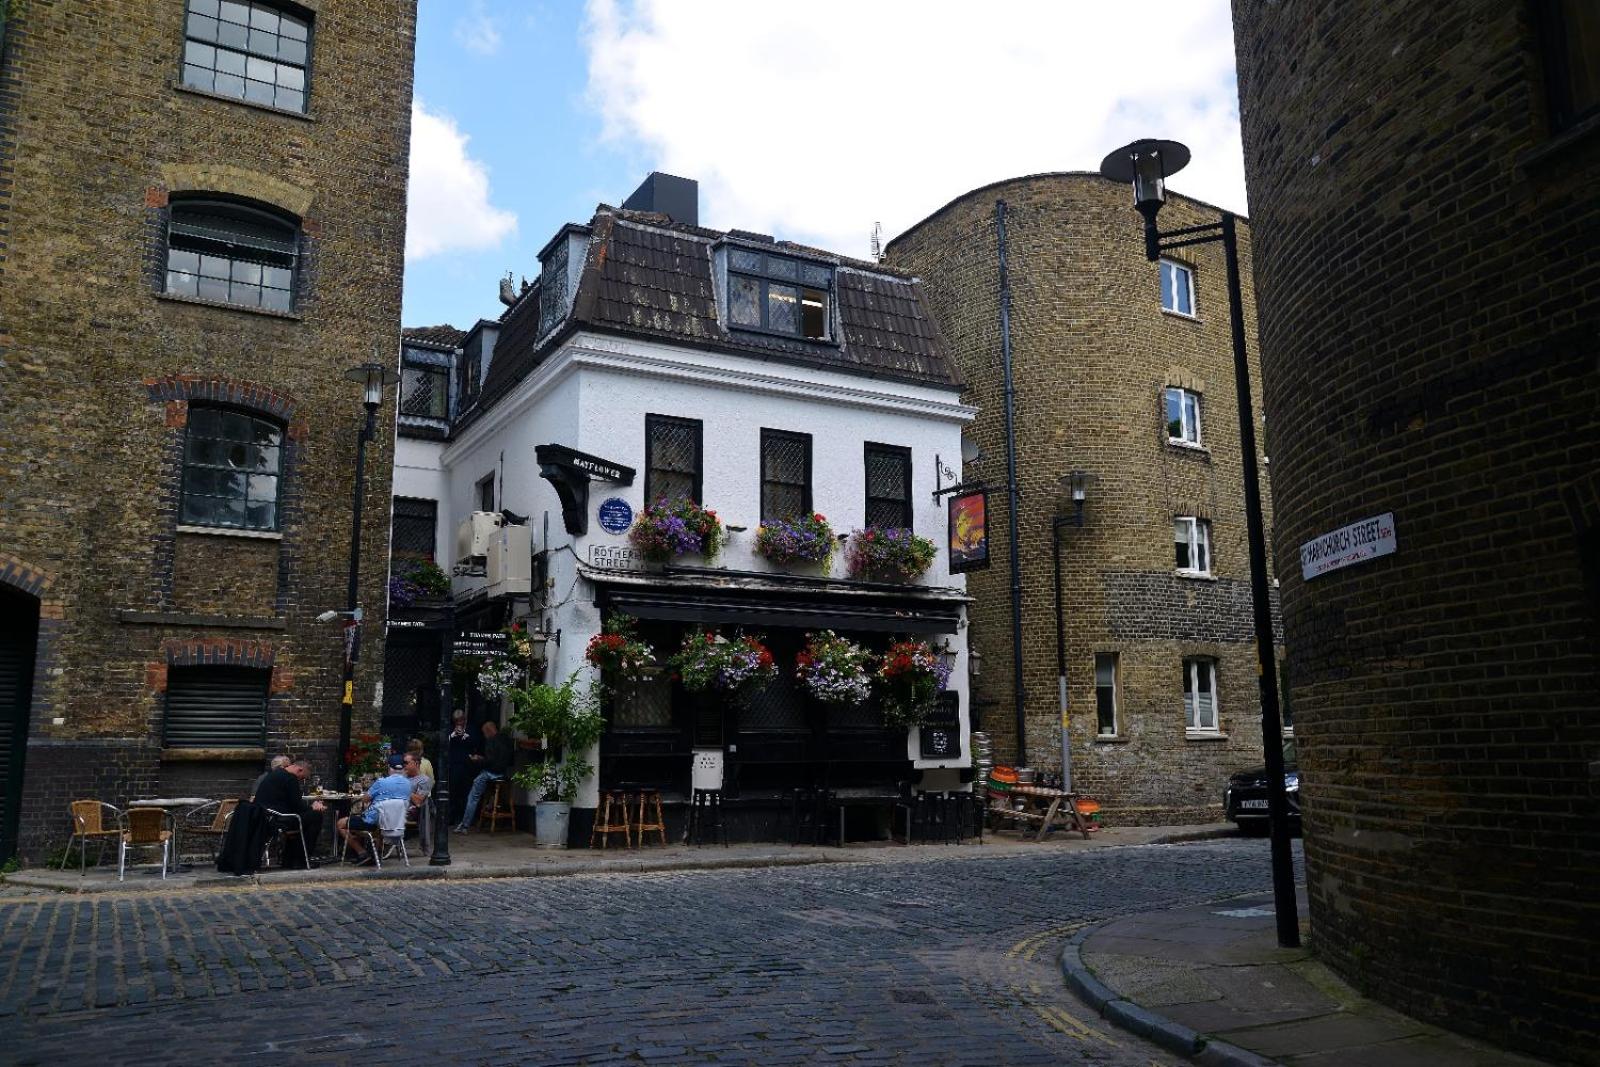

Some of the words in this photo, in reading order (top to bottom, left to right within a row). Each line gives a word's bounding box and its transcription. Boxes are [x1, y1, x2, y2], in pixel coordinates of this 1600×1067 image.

[573, 458, 621, 478] MAYFLOWER
[1352, 519, 1380, 547] STREET
[594, 547, 641, 560] ROTHERH
[594, 558, 631, 568] STREET
